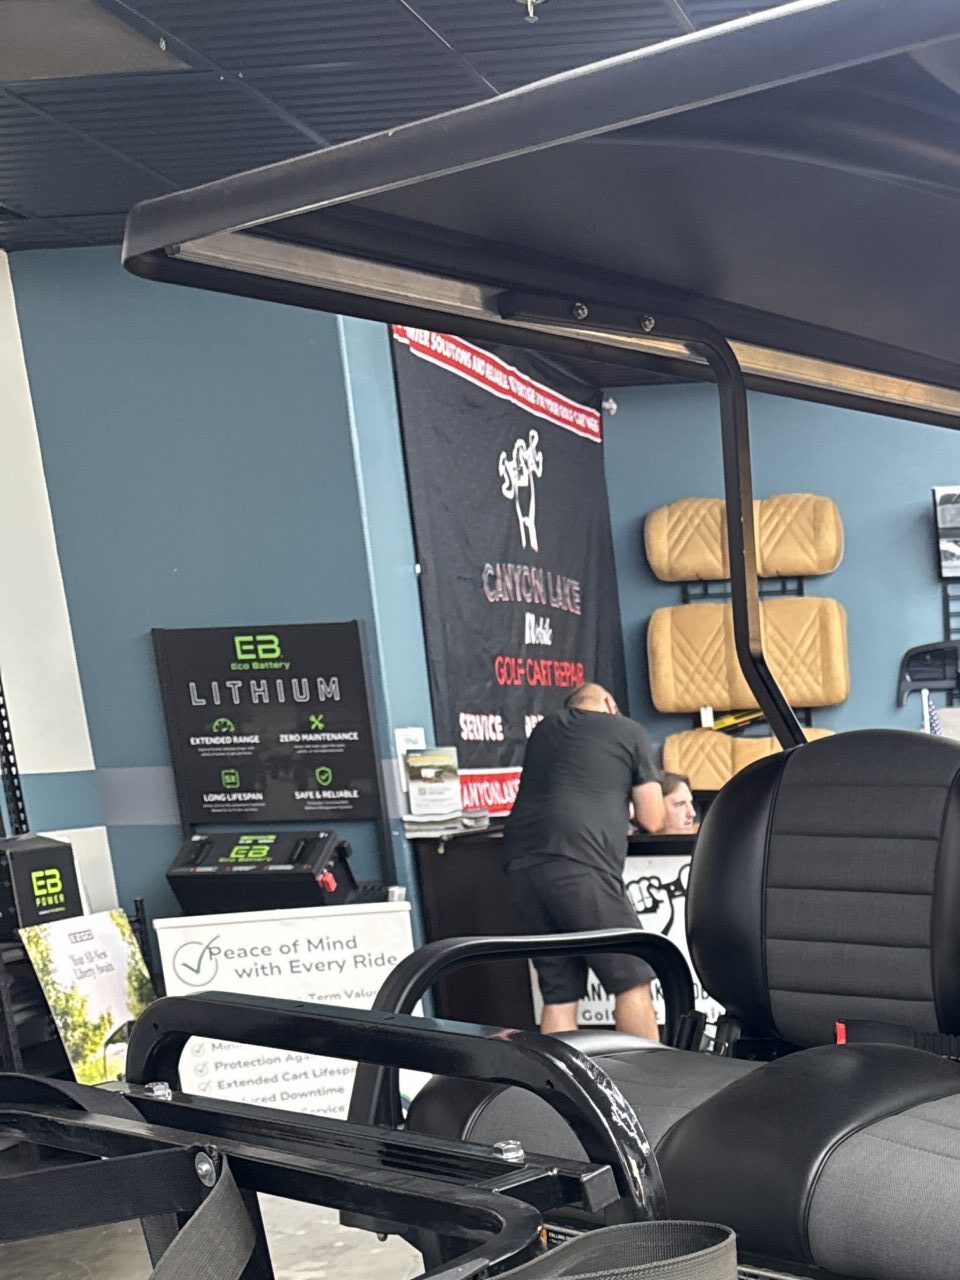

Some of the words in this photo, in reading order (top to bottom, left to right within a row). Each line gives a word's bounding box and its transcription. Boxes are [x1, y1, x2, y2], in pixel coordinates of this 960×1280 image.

[482, 562, 546, 604] CANYON
[546, 570, 583, 615] LAKE
[233, 634, 282, 660] EB
[230, 661, 250, 671] Eco
[250, 660, 291, 671] Battery
[494, 654, 526, 687] GOLF
[525, 657, 554, 689] CART
[188, 675, 342, 707] LITHIUM
[278, 733, 301, 743] ZERO
[301, 731, 360, 743] MAINTENANCE
[458, 711, 505, 742] SERVICE
[189, 737, 233, 747] EXTENDED
[232, 734, 261, 745] RANGE
[202, 793, 226, 803] LONG
[225, 792, 264, 802] LIFESPAN
[294, 790, 315, 800] SAFE
[321, 789, 360, 799] RELIABLE
[31, 868, 63, 897] EB
[208, 945, 272, 961] Peace
[279, 939, 302, 956] of
[307, 935, 358, 952] Mind
[234, 961, 282, 979] with
[289, 957, 347, 976] Every
[353, 953, 398, 970] Ride
[215, 1055, 282, 1072] Protection
[217, 1074, 279, 1090] Extended
[281, 1071, 310, 1082] Cart
[279, 1085, 346, 1101] Downtime
